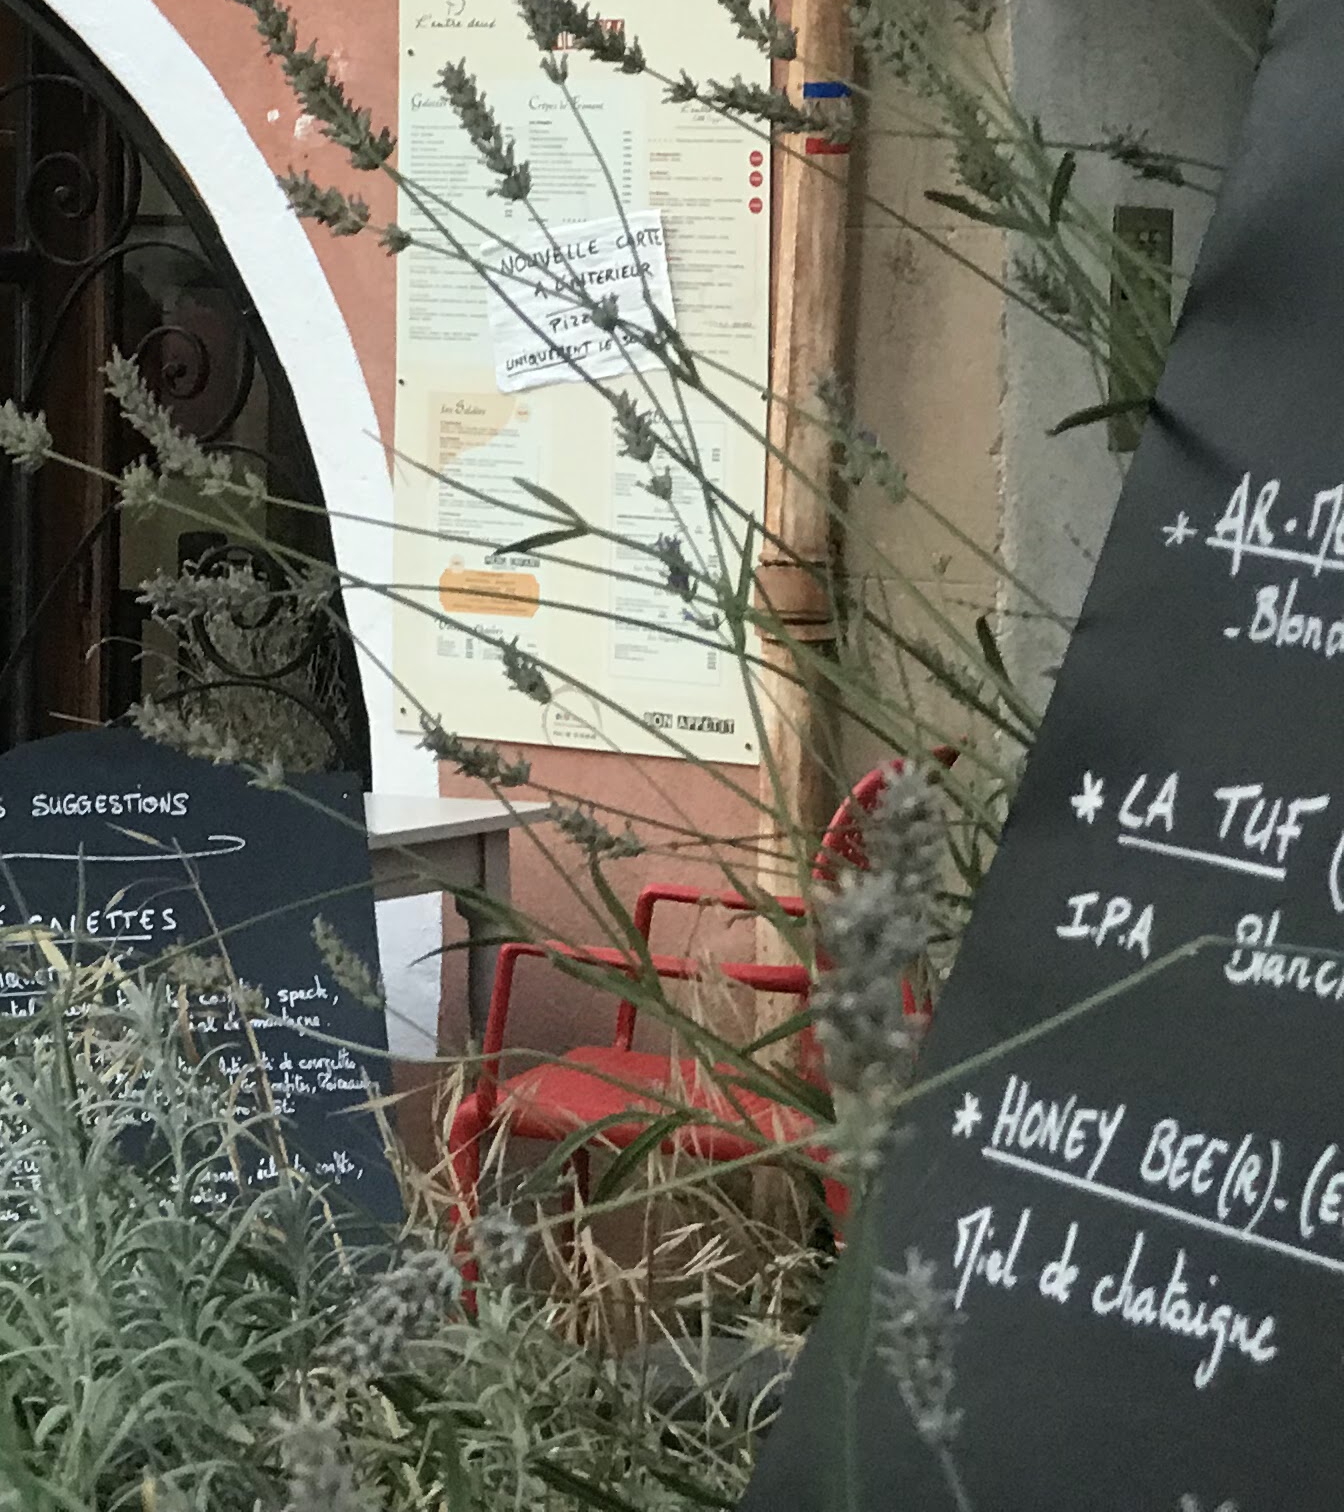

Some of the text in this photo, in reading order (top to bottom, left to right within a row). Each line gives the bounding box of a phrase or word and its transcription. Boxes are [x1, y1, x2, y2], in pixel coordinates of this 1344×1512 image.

[499, 238, 600, 276] NOUVELLE
[1118, 771, 1330, 862] LA TUF
[1056, 891, 1155, 960] I.P.A
[1223, 907, 1344, 1001] Blanc
[991, 1074, 1127, 1182] HONEY
[952, 1207, 1278, 1390] Miel de chataigne
